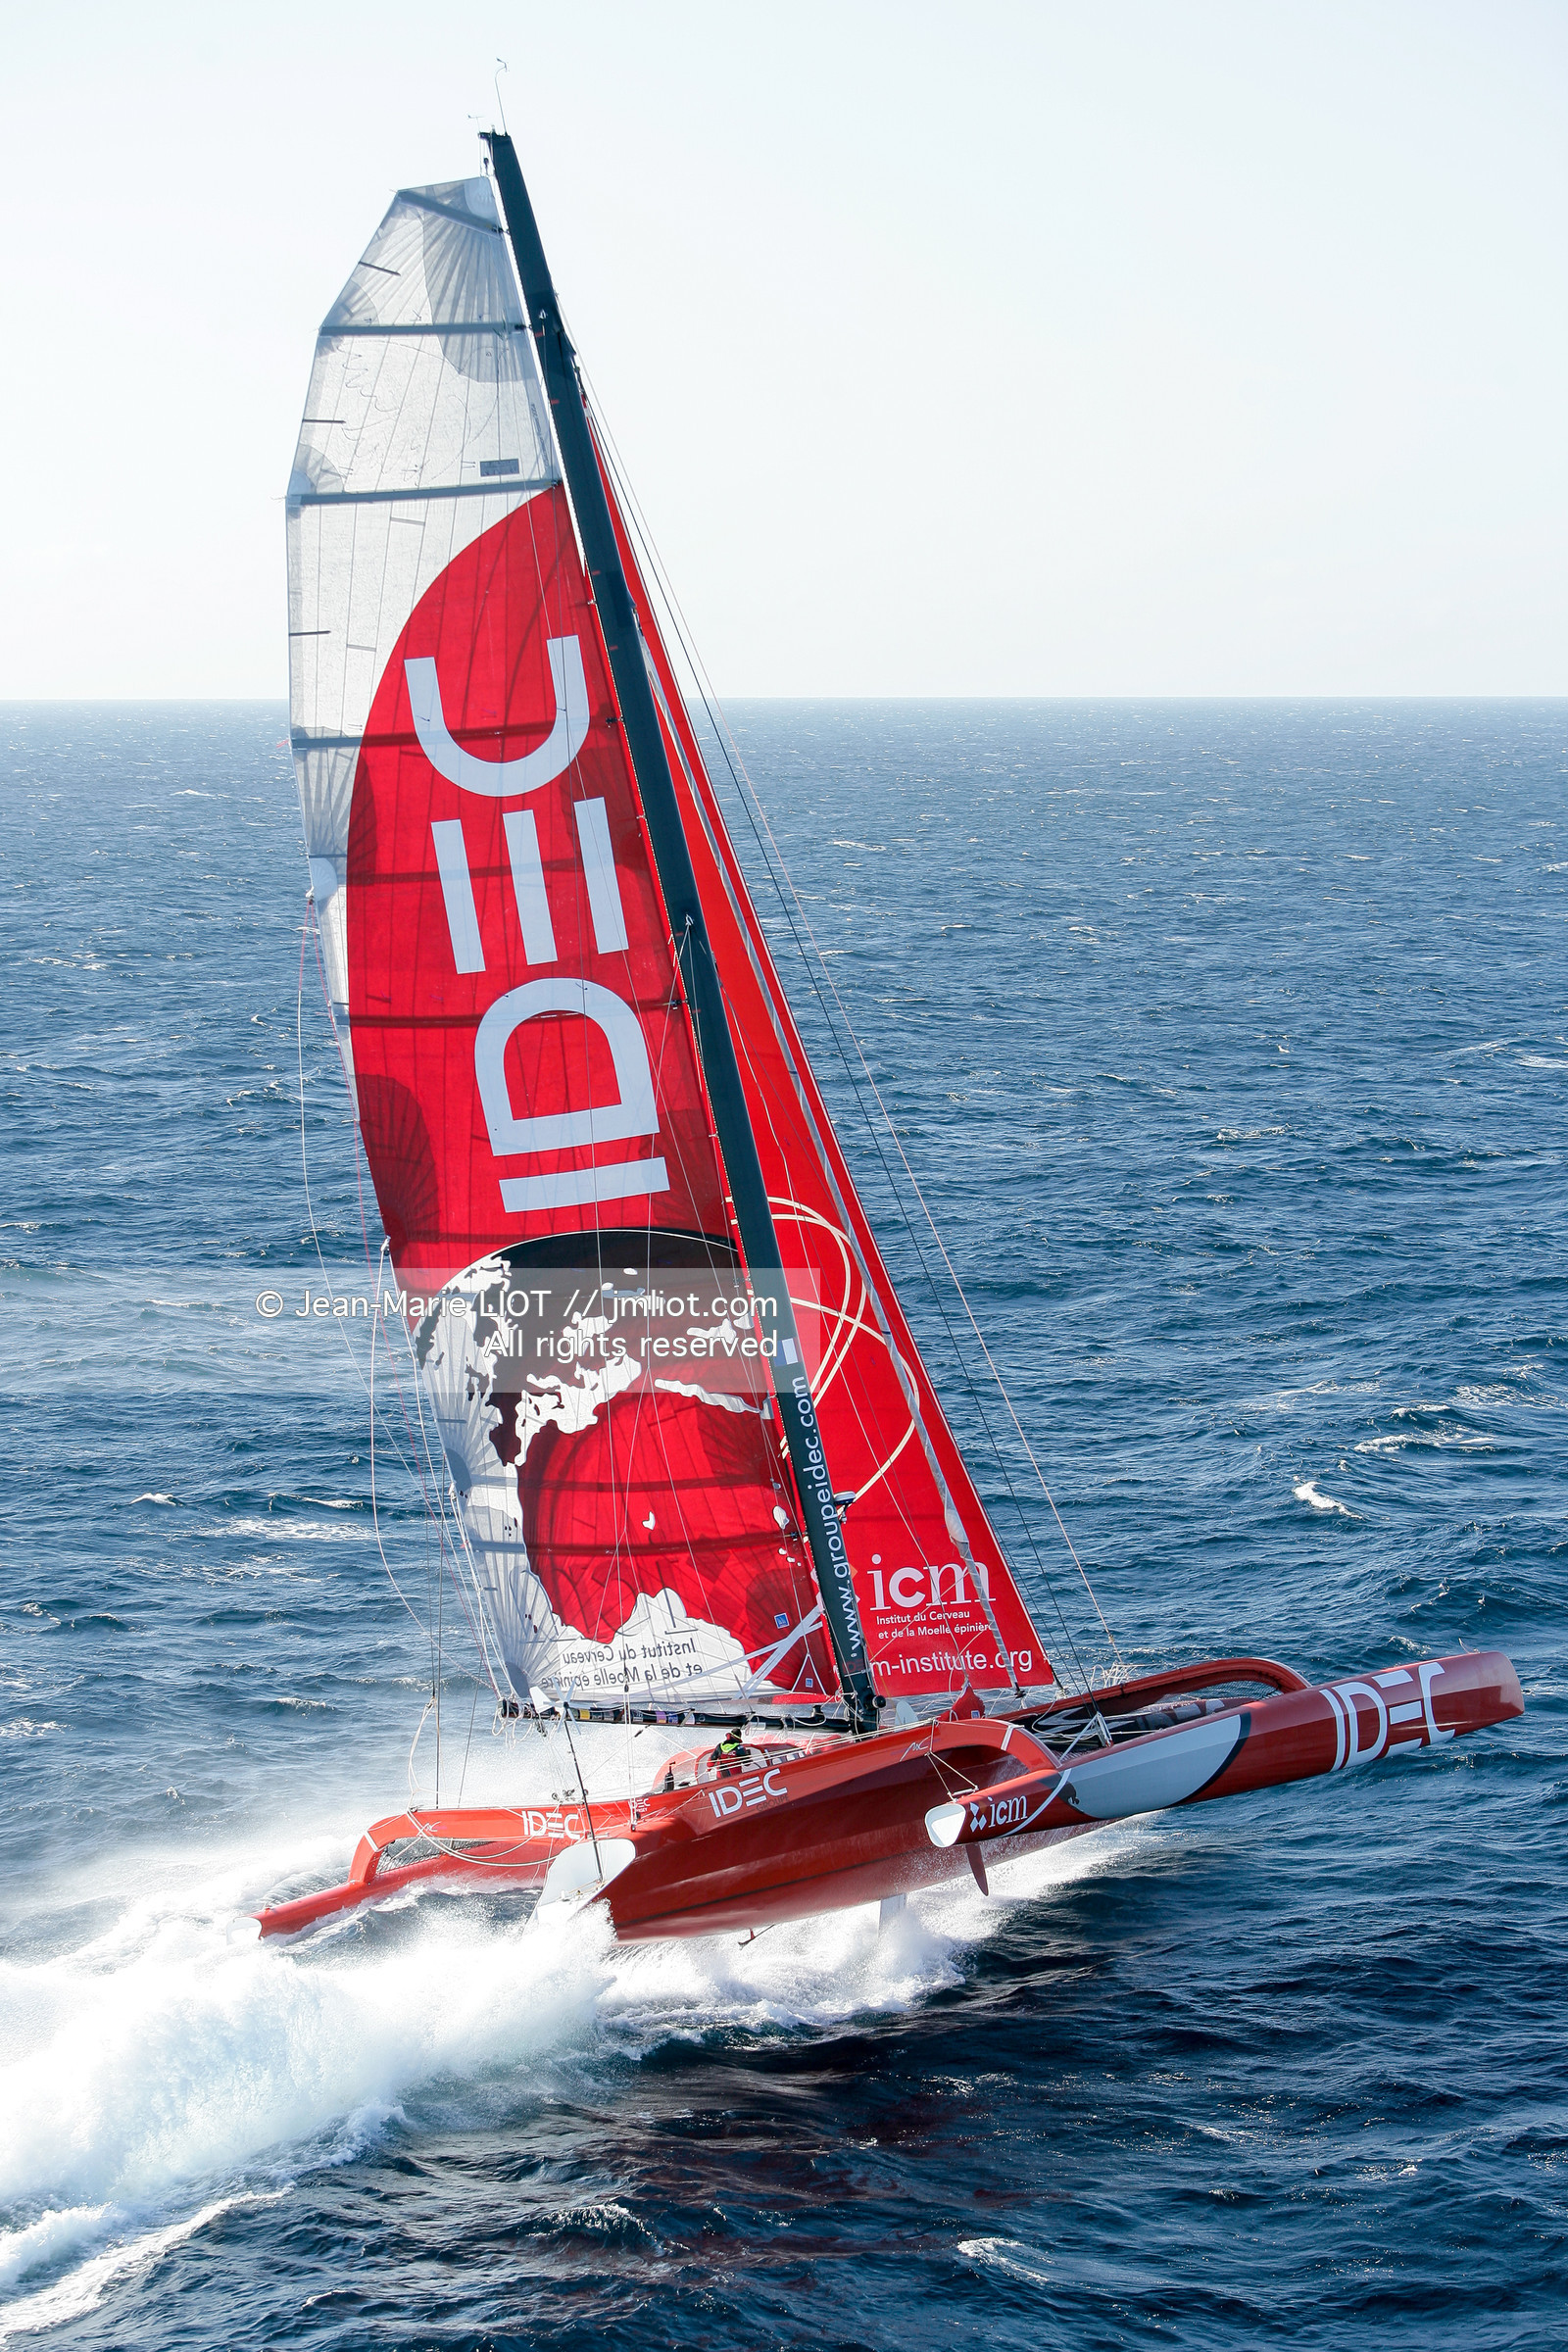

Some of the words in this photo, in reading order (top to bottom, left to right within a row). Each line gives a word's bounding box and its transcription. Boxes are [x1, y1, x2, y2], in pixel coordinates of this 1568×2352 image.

[404, 635, 670, 1213] IDEC
[792, 1376, 861, 1650] www.groupeidec.com
[867, 1554, 996, 1611] icm
[876, 1613, 910, 1625] Institut
[913, 1611, 926, 1622] du
[929, 1609, 970, 1621] Cerveau
[878, 1630, 889, 1640] et
[891, 1628, 904, 1639] de
[906, 1627, 915, 1637] la
[917, 1624, 951, 1637] Moelle
[1319, 1661, 1455, 1773] IDEC
[709, 1768, 788, 1818] IDEC
[988, 1795, 1028, 1829] icm
[521, 1810, 581, 1840] IDEC
